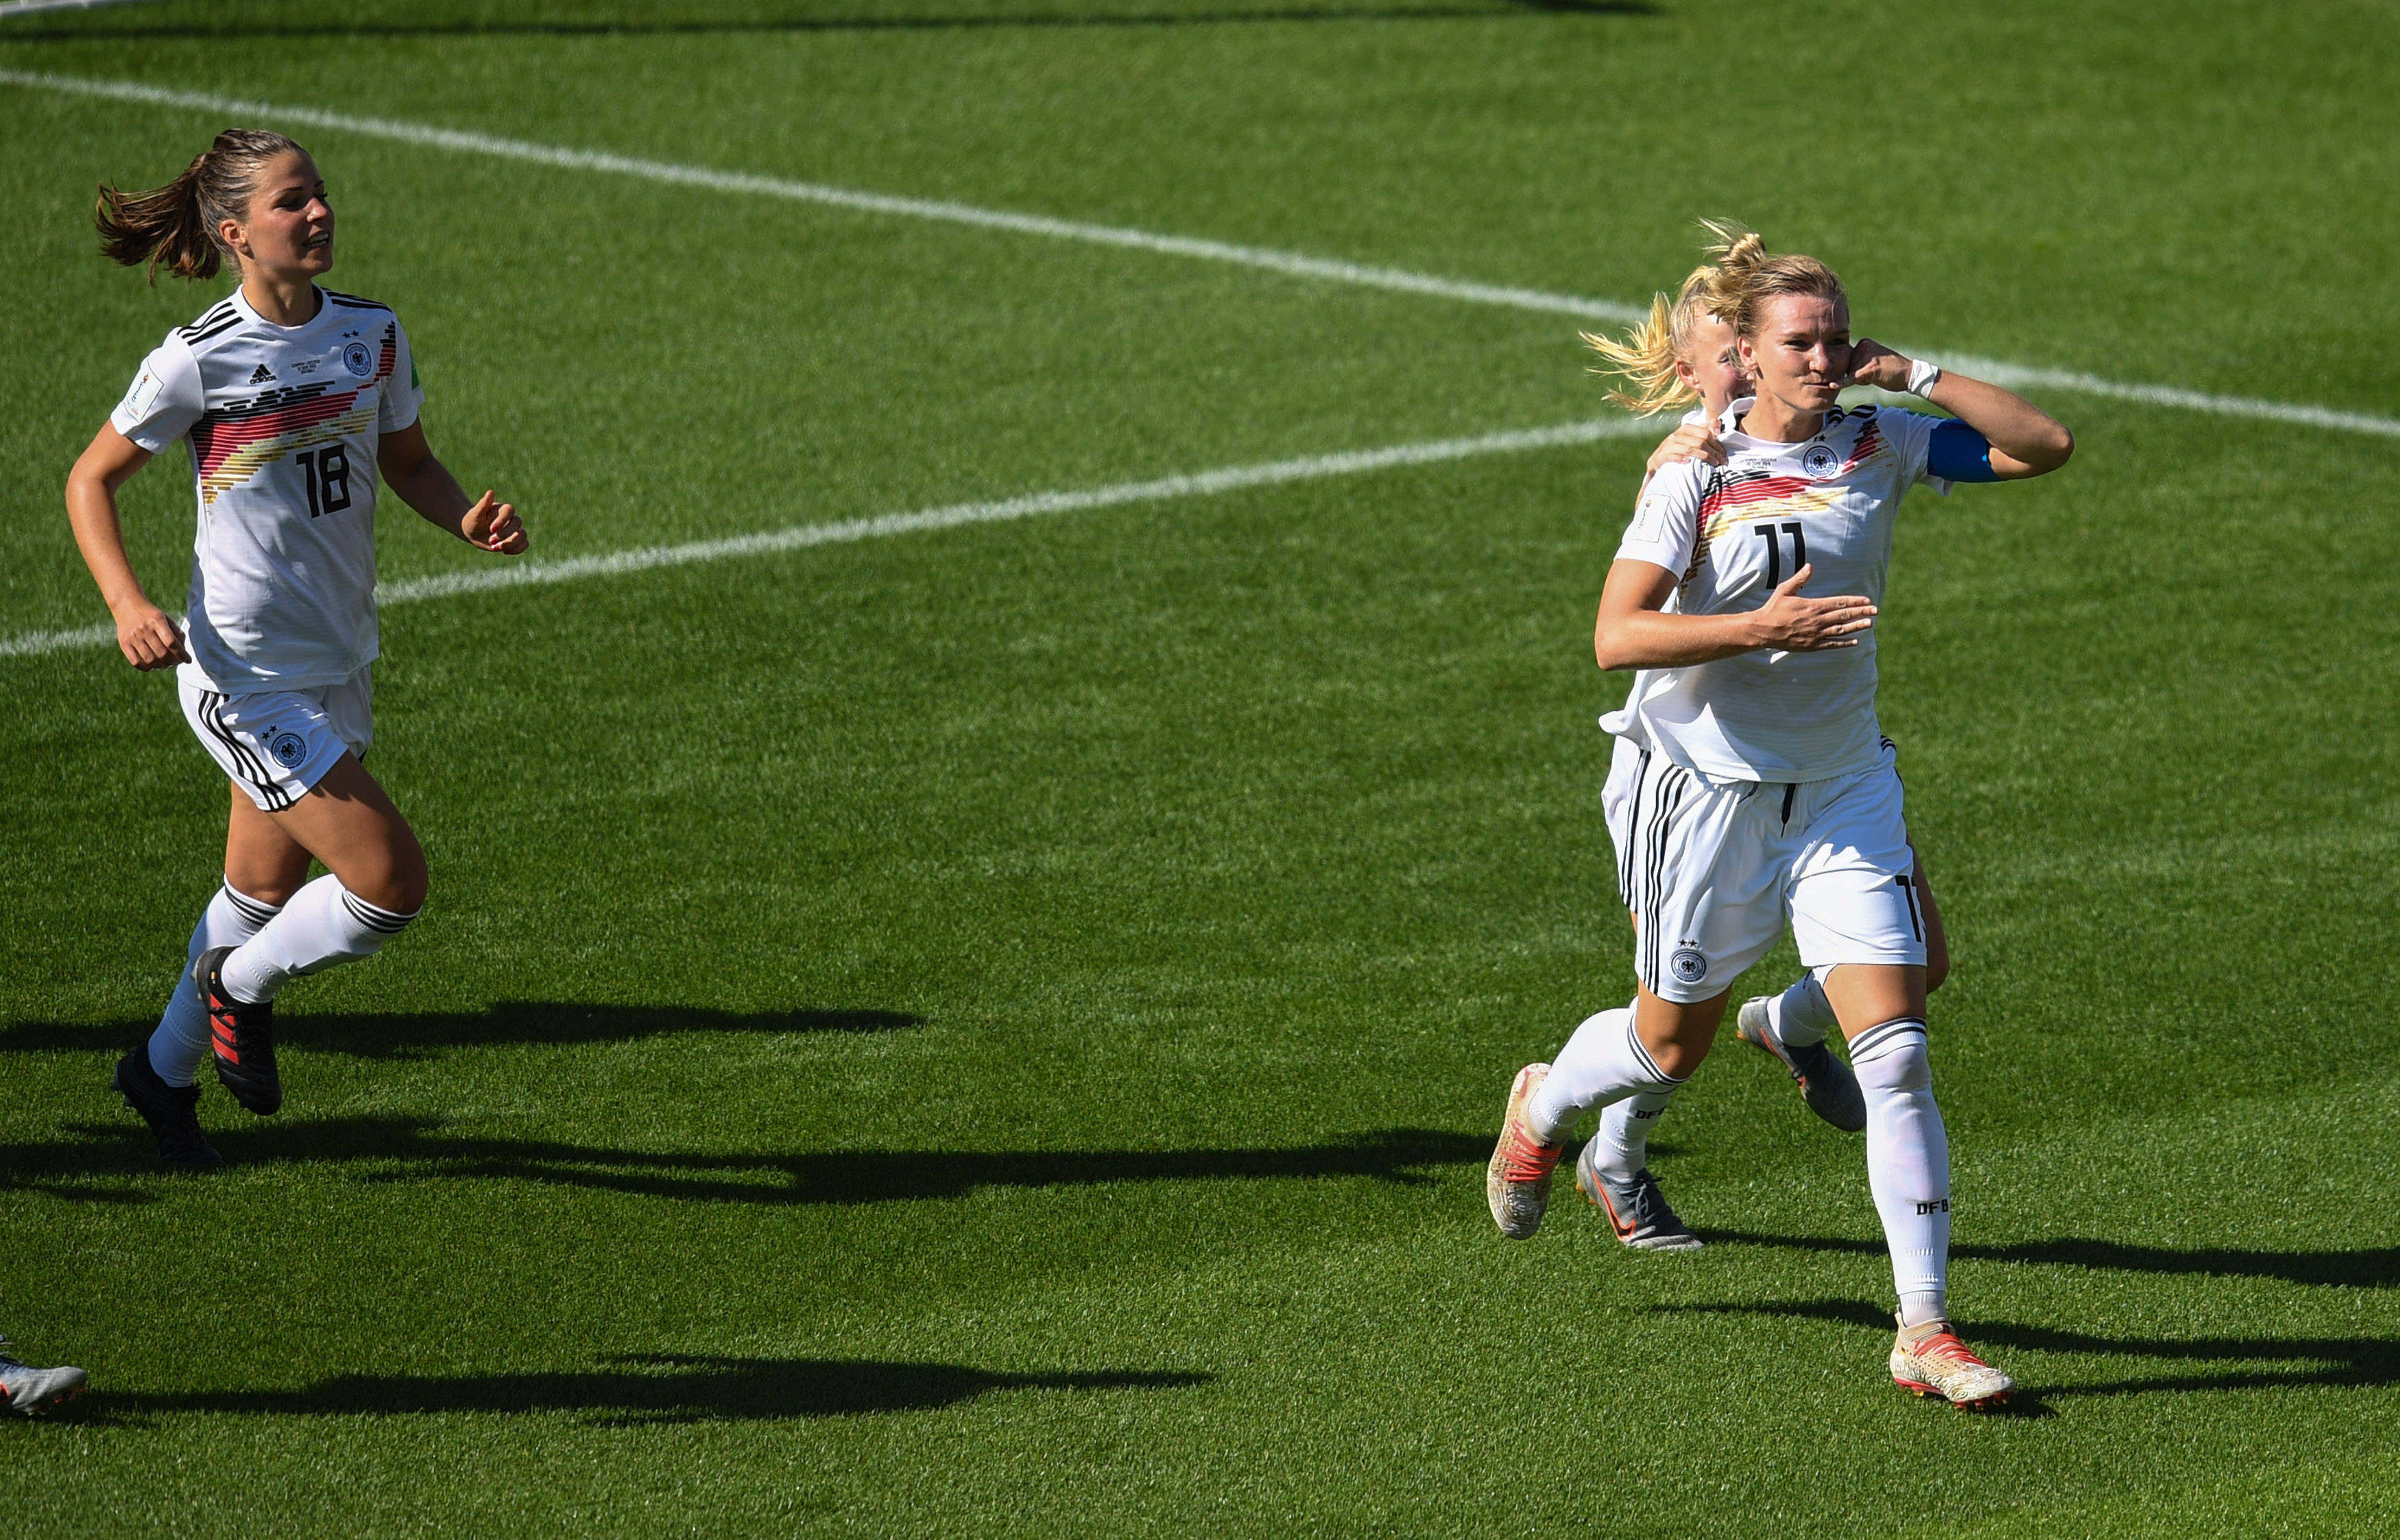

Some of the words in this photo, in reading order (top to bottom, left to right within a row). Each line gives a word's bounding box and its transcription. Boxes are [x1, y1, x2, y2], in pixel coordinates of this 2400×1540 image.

[296, 444, 351, 518] 18
[1753, 522, 1805, 589] 11
[1917, 1199, 1949, 1216] DFB
